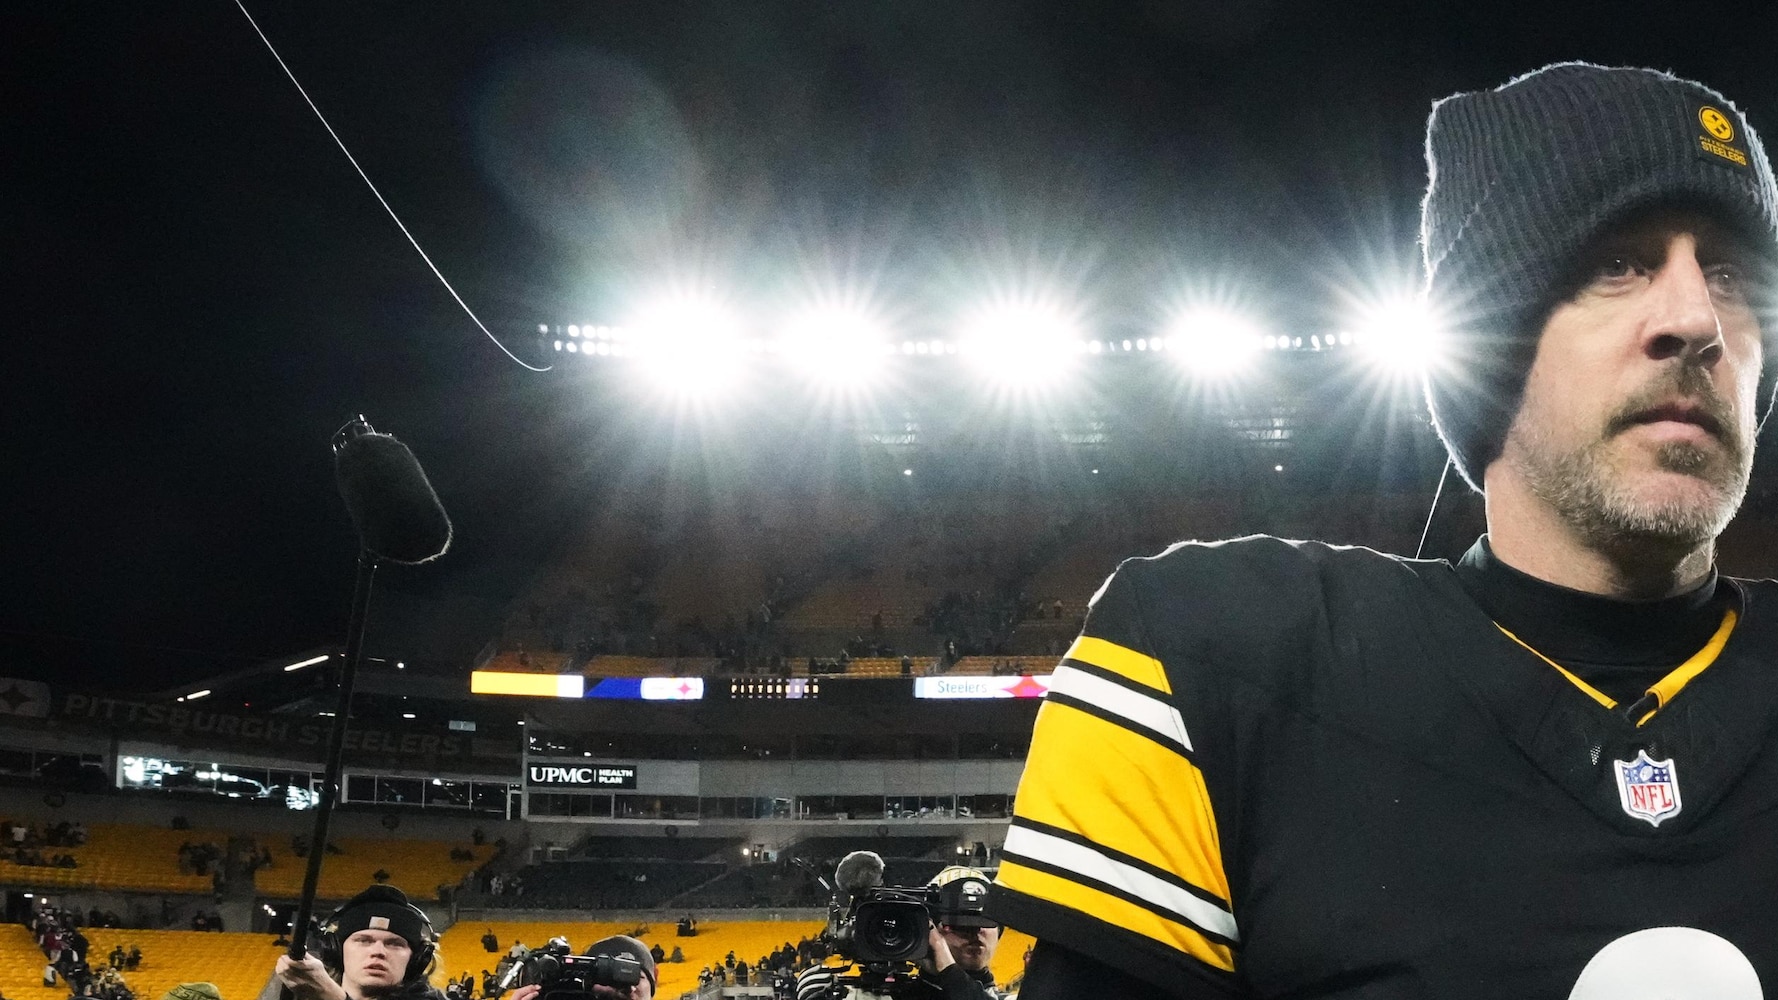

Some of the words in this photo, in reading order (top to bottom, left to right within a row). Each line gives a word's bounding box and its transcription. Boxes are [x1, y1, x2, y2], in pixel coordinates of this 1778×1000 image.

[937, 680, 988, 694] Steelers
[65, 693, 290, 742] PITTSBURGH
[530, 767, 594, 783] UPMC
[599, 769, 633, 777] HEALTH
[599, 776, 623, 784] PLAN
[1630, 784, 1673, 812] NFL
